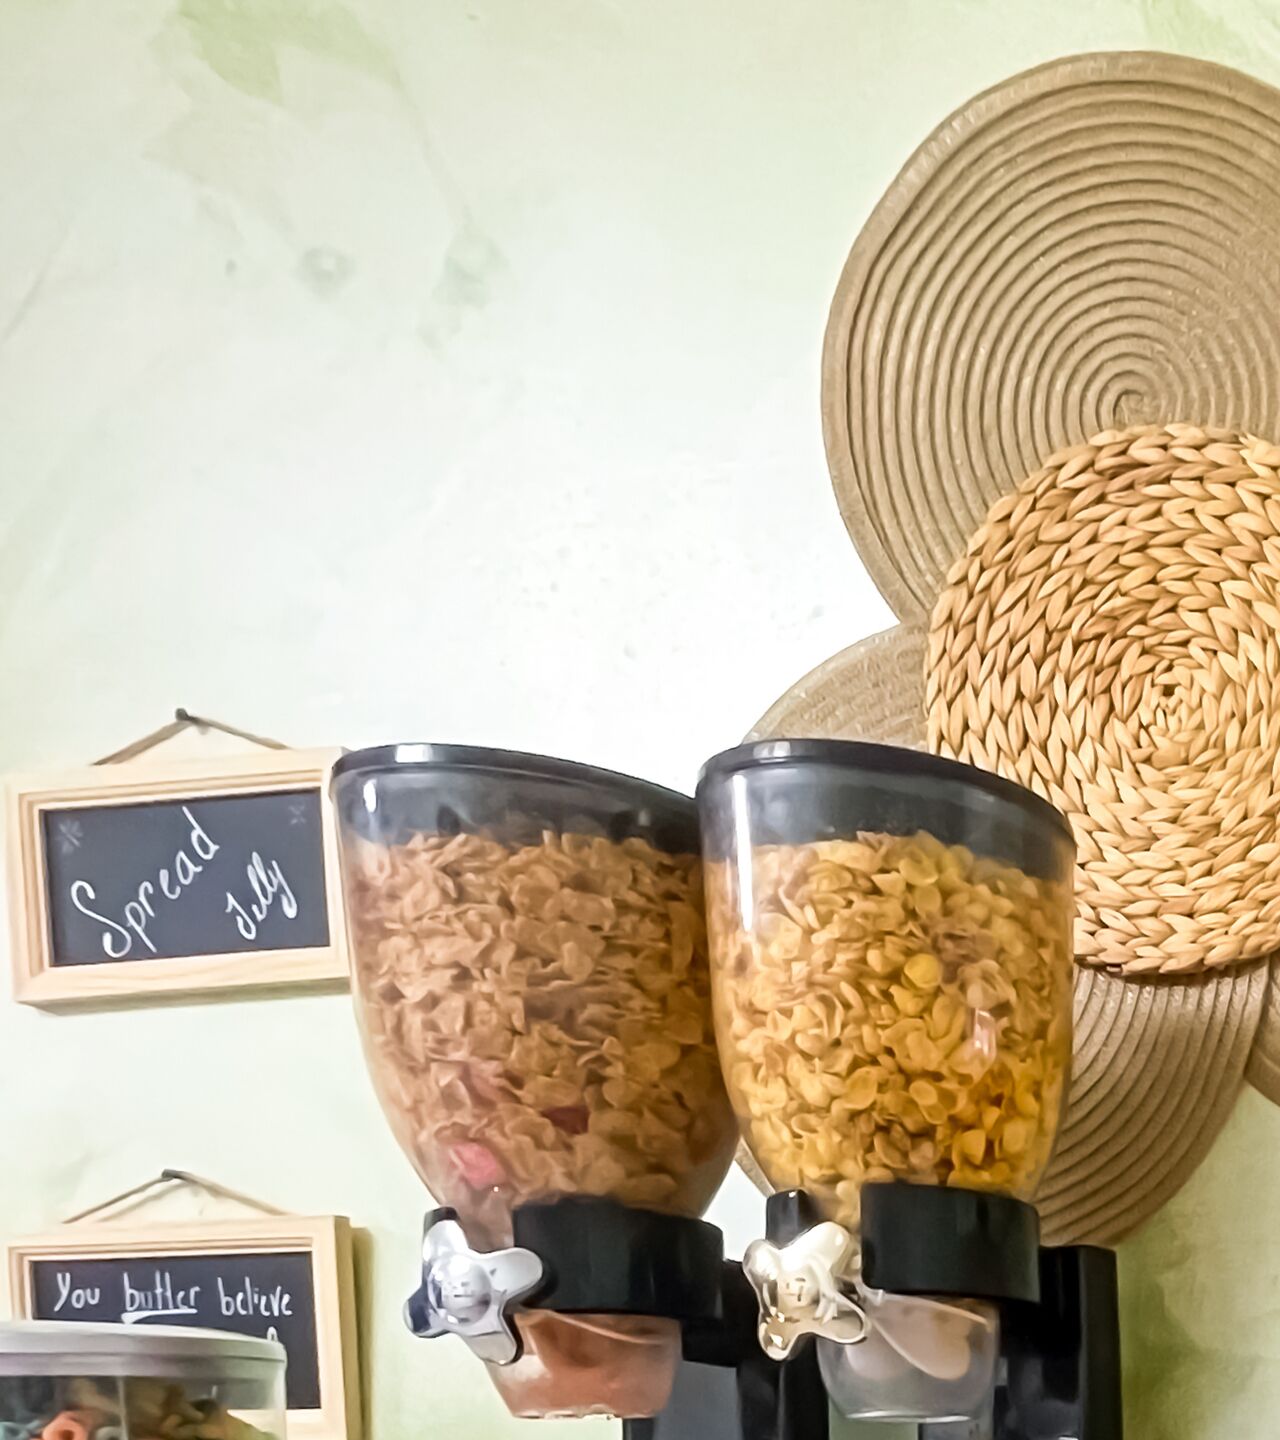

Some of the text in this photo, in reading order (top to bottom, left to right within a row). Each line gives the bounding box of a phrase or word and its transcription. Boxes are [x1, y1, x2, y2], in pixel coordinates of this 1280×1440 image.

[70, 805, 220, 959] Spread
[224, 851, 297, 940] Jelly
[53, 1270, 293, 1317] You butter believe
